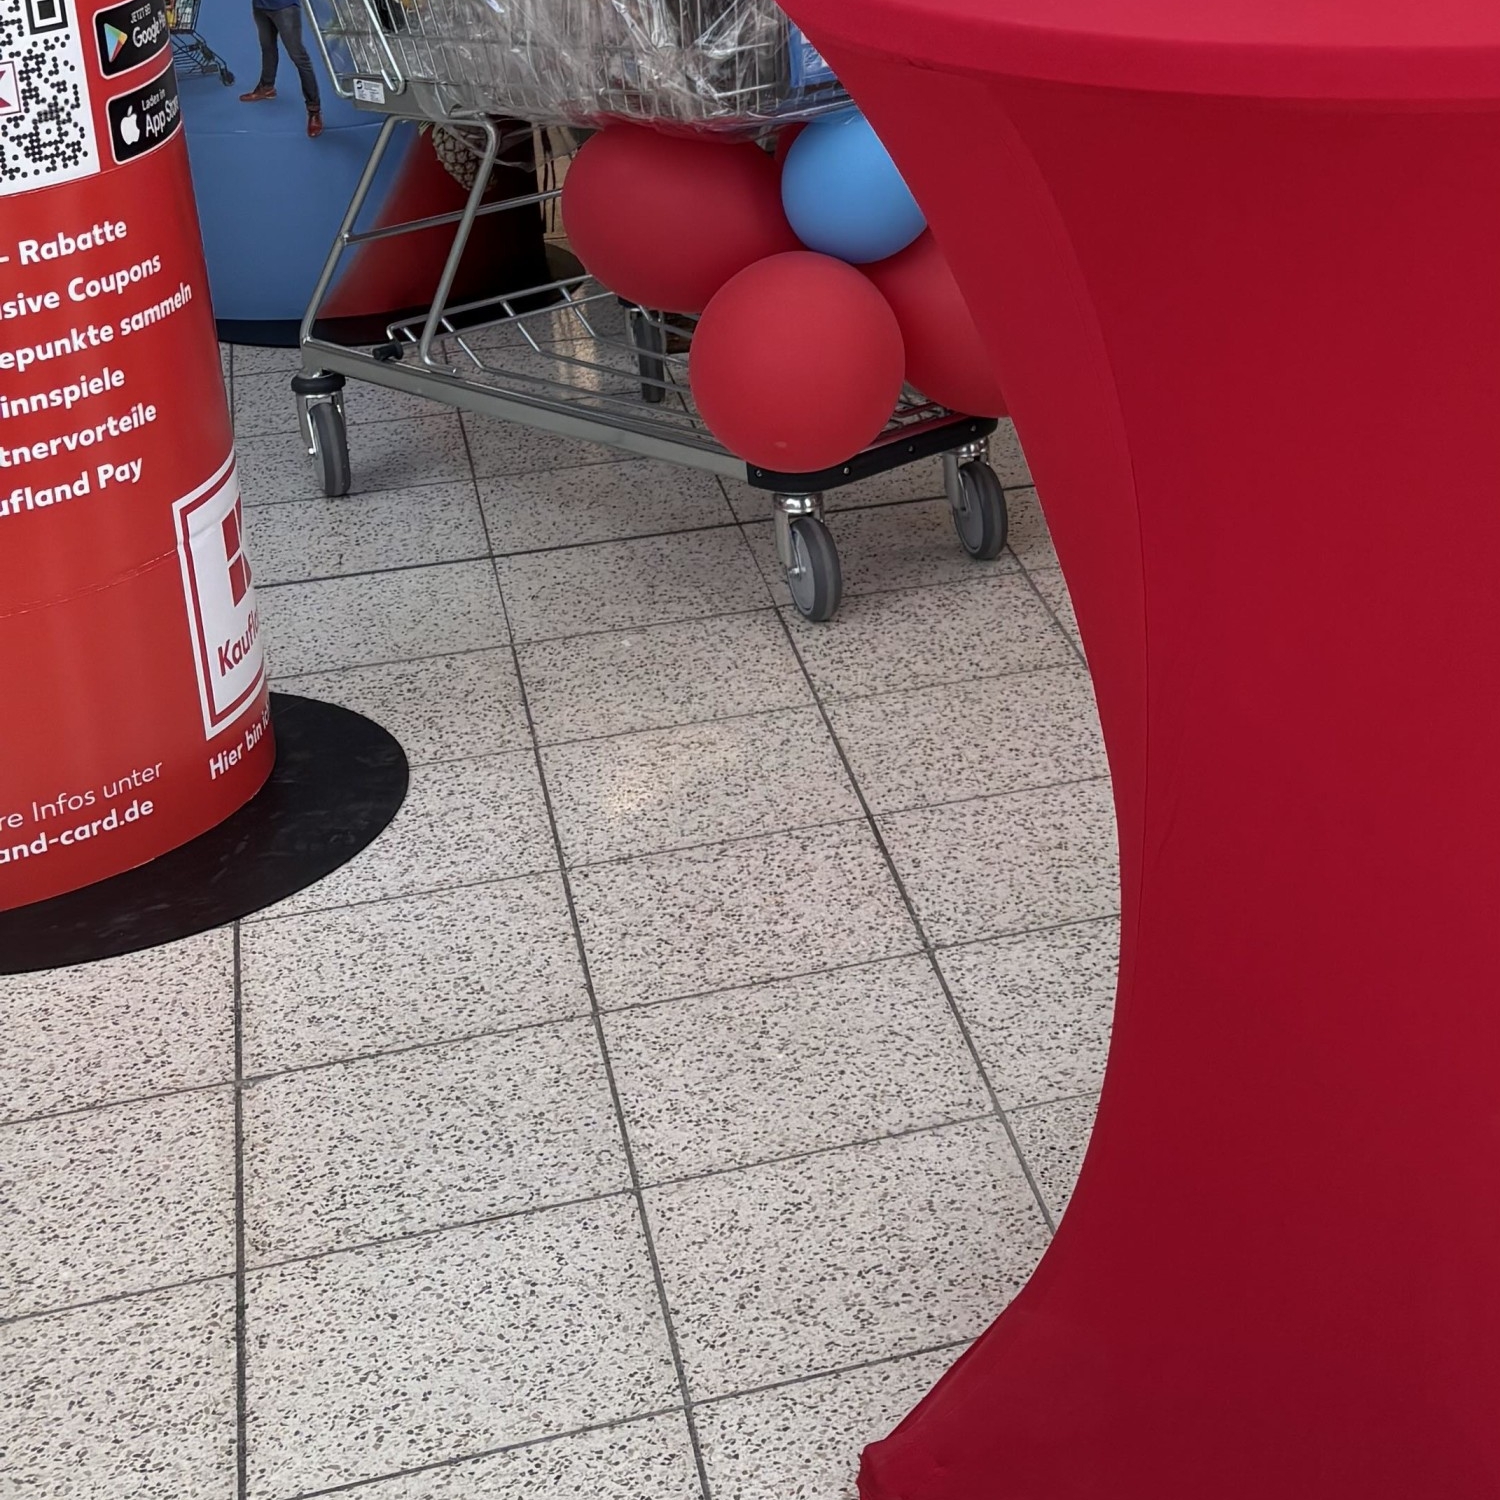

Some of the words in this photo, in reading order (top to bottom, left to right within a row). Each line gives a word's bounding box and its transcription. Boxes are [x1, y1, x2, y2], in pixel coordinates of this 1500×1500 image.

[133, 16, 157, 48] Google
[142, 93, 160, 111] Laden
[146, 108, 166, 138] App
[18, 220, 127, 265] Rabatte
[0, 291, 60, 320] sive
[67, 255, 161, 302] Coupons
[0, 325, 114, 372] epunkte
[120, 282, 192, 336] sammeln
[0, 367, 125, 418] innspiele
[0, 403, 157, 468] tnervorteile
[97, 458, 143, 489] Pay
[209, 743, 243, 780] Hier
[245, 723, 263, 751] bin
[33, 789, 96, 822] Infos
[103, 760, 163, 797] unter
[0, 798, 154, 864] and-card.de
